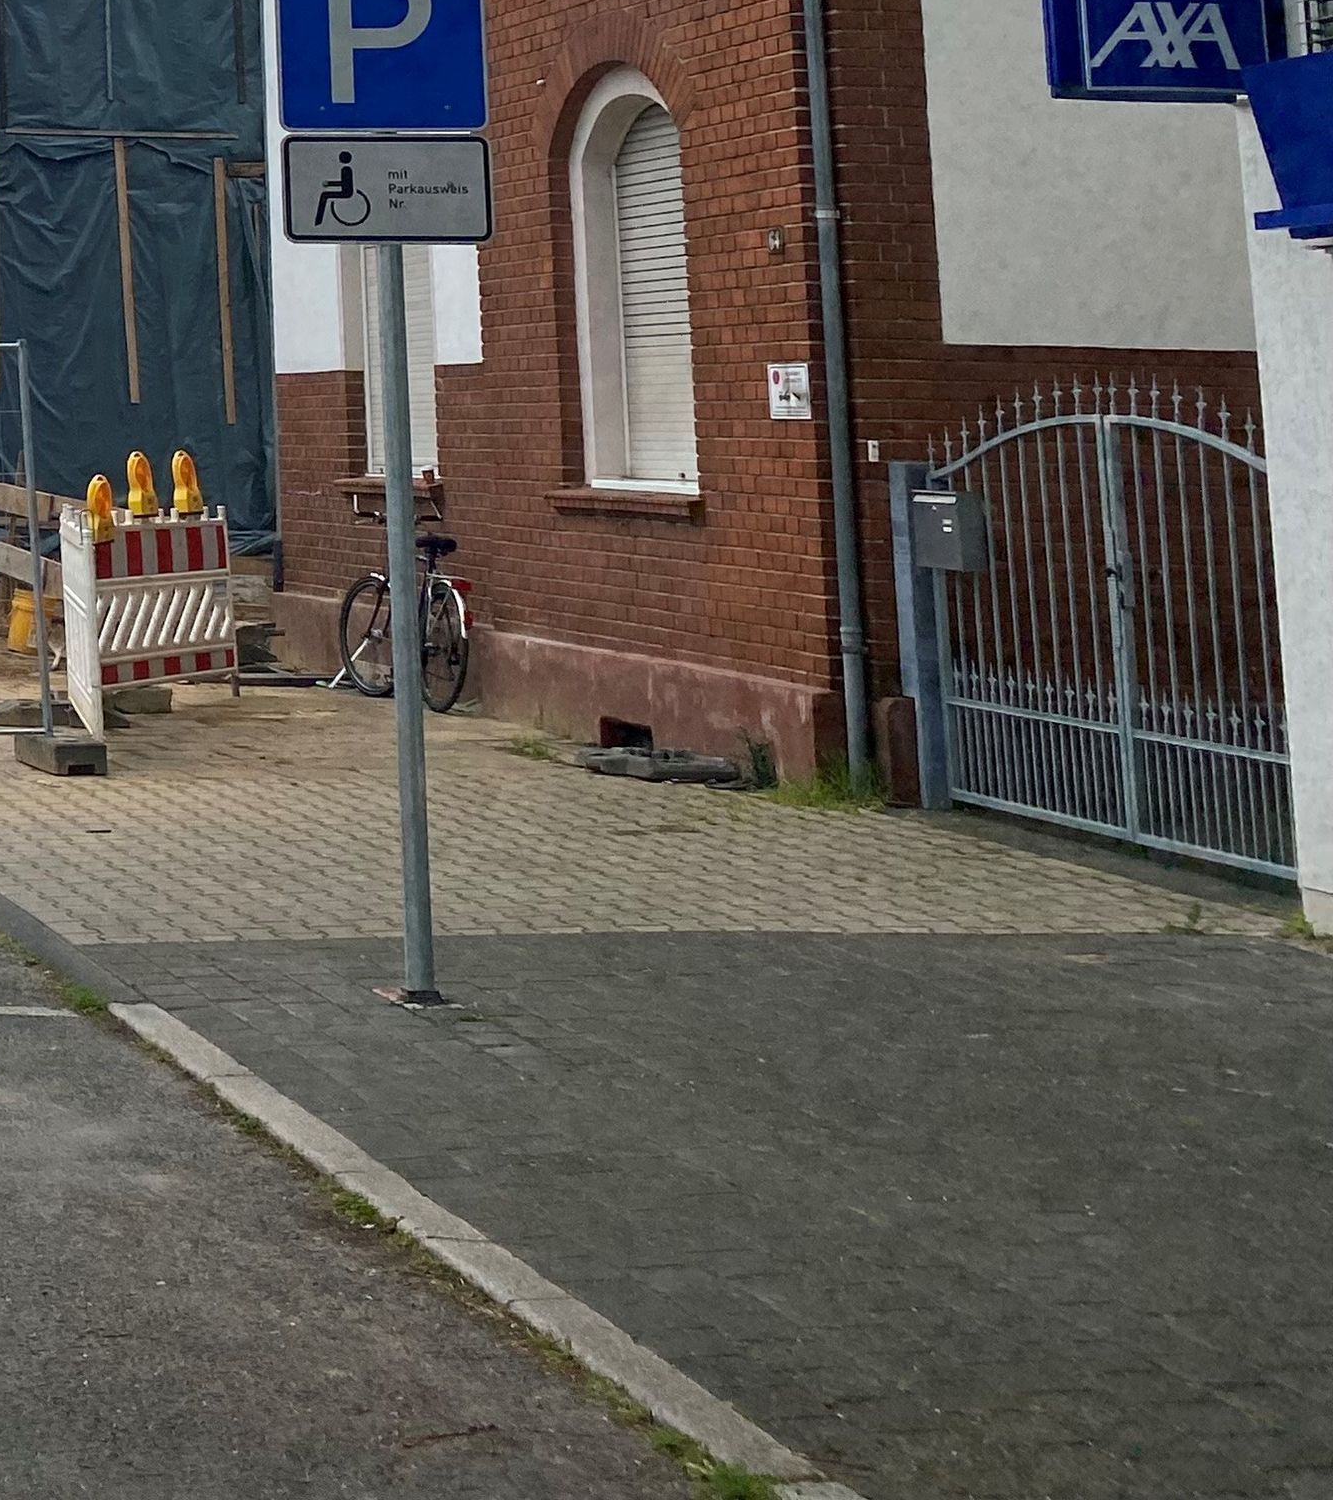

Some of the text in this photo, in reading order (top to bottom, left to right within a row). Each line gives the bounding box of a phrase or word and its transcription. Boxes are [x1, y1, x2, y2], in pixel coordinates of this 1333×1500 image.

[1090, 1, 1242, 71] AXA
[387, 168, 408, 180] mit
[388, 182, 469, 195] Parkausweis
